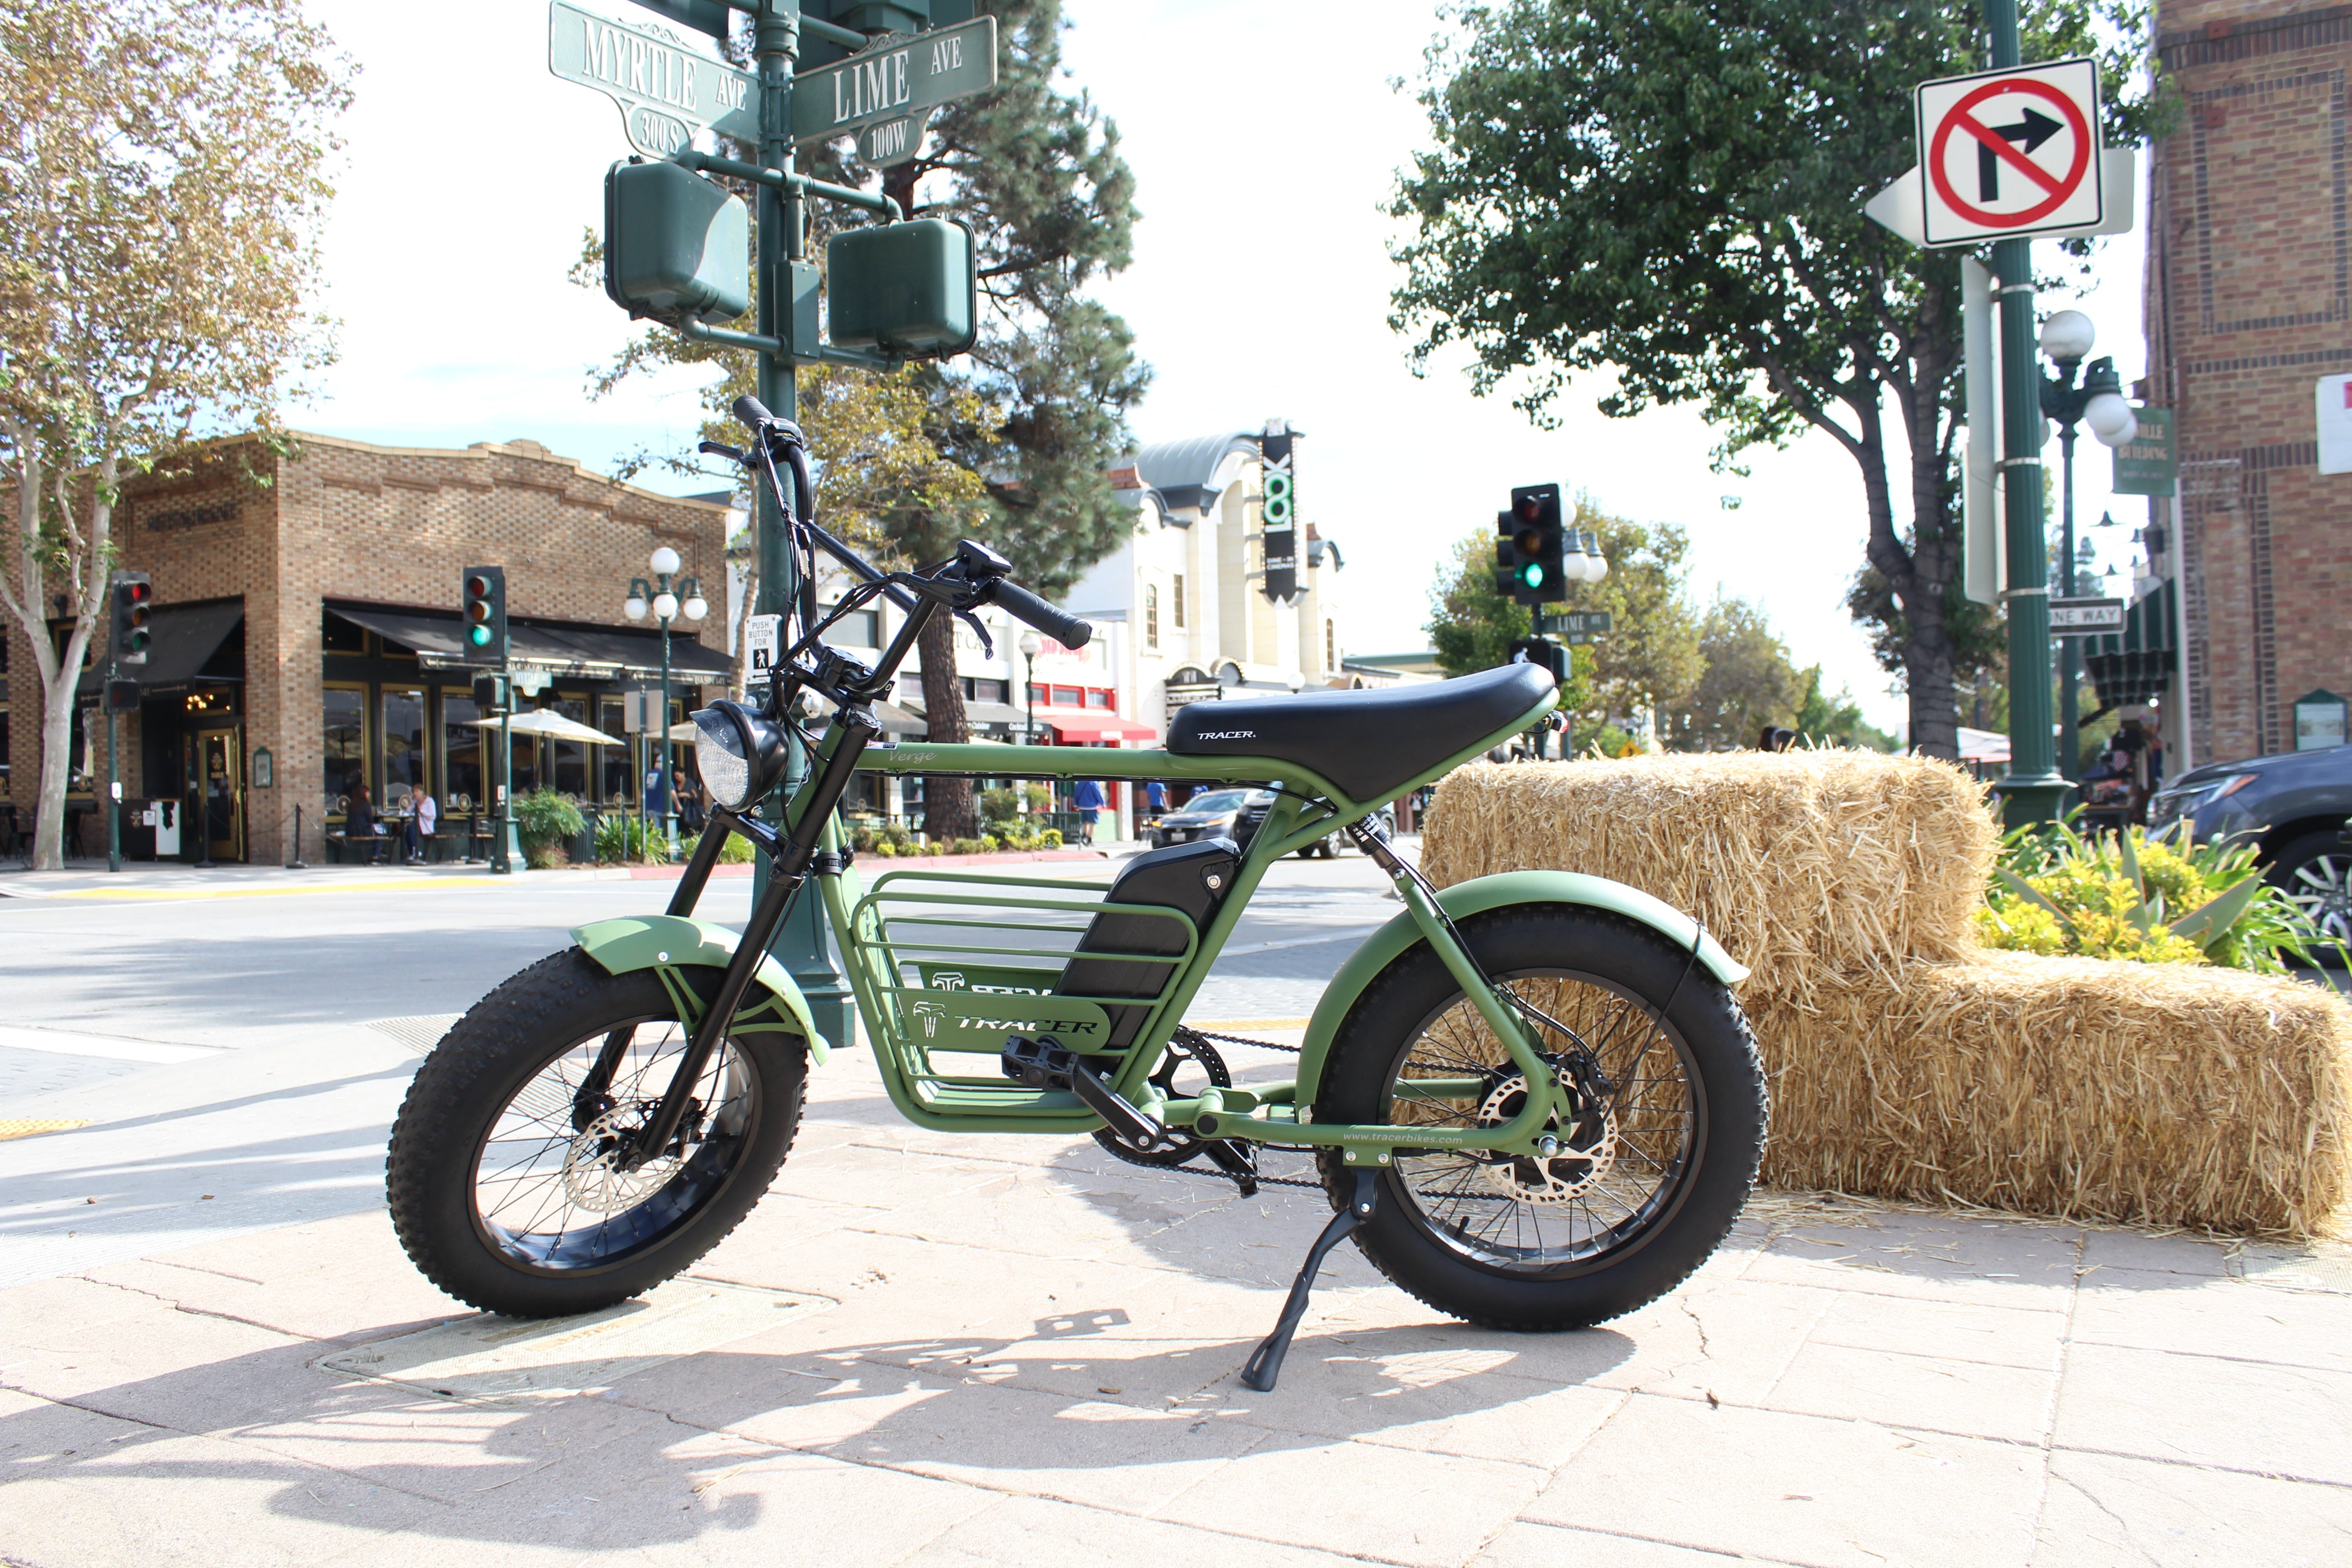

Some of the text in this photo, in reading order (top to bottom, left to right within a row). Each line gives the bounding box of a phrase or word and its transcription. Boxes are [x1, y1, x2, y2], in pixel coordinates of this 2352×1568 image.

[583, 18, 747, 113] MYRTLE AVE
[833, 36, 962, 124] LIME AVE
[871, 120, 909, 160] 100W
[2081, 608, 2117, 622] WAY
[751, 621, 769, 630] PUSH
[1557, 615, 1585, 632] LIME
[748, 629, 773, 639] BUTTON
[754, 638, 767, 647] FOR
[515, 671, 538, 685] MYRTLE
[694, 675, 725, 686] BASIN 141
[140, 687, 150, 696] 141
[971, 721, 991, 730] Cuisine
[1008, 722, 1029, 731] Cocktail
[889, 750, 938, 764] Verge
[955, 1015, 1098, 1035] TRACER
[1343, 1132, 1463, 1145] www.tracerbikes.com
